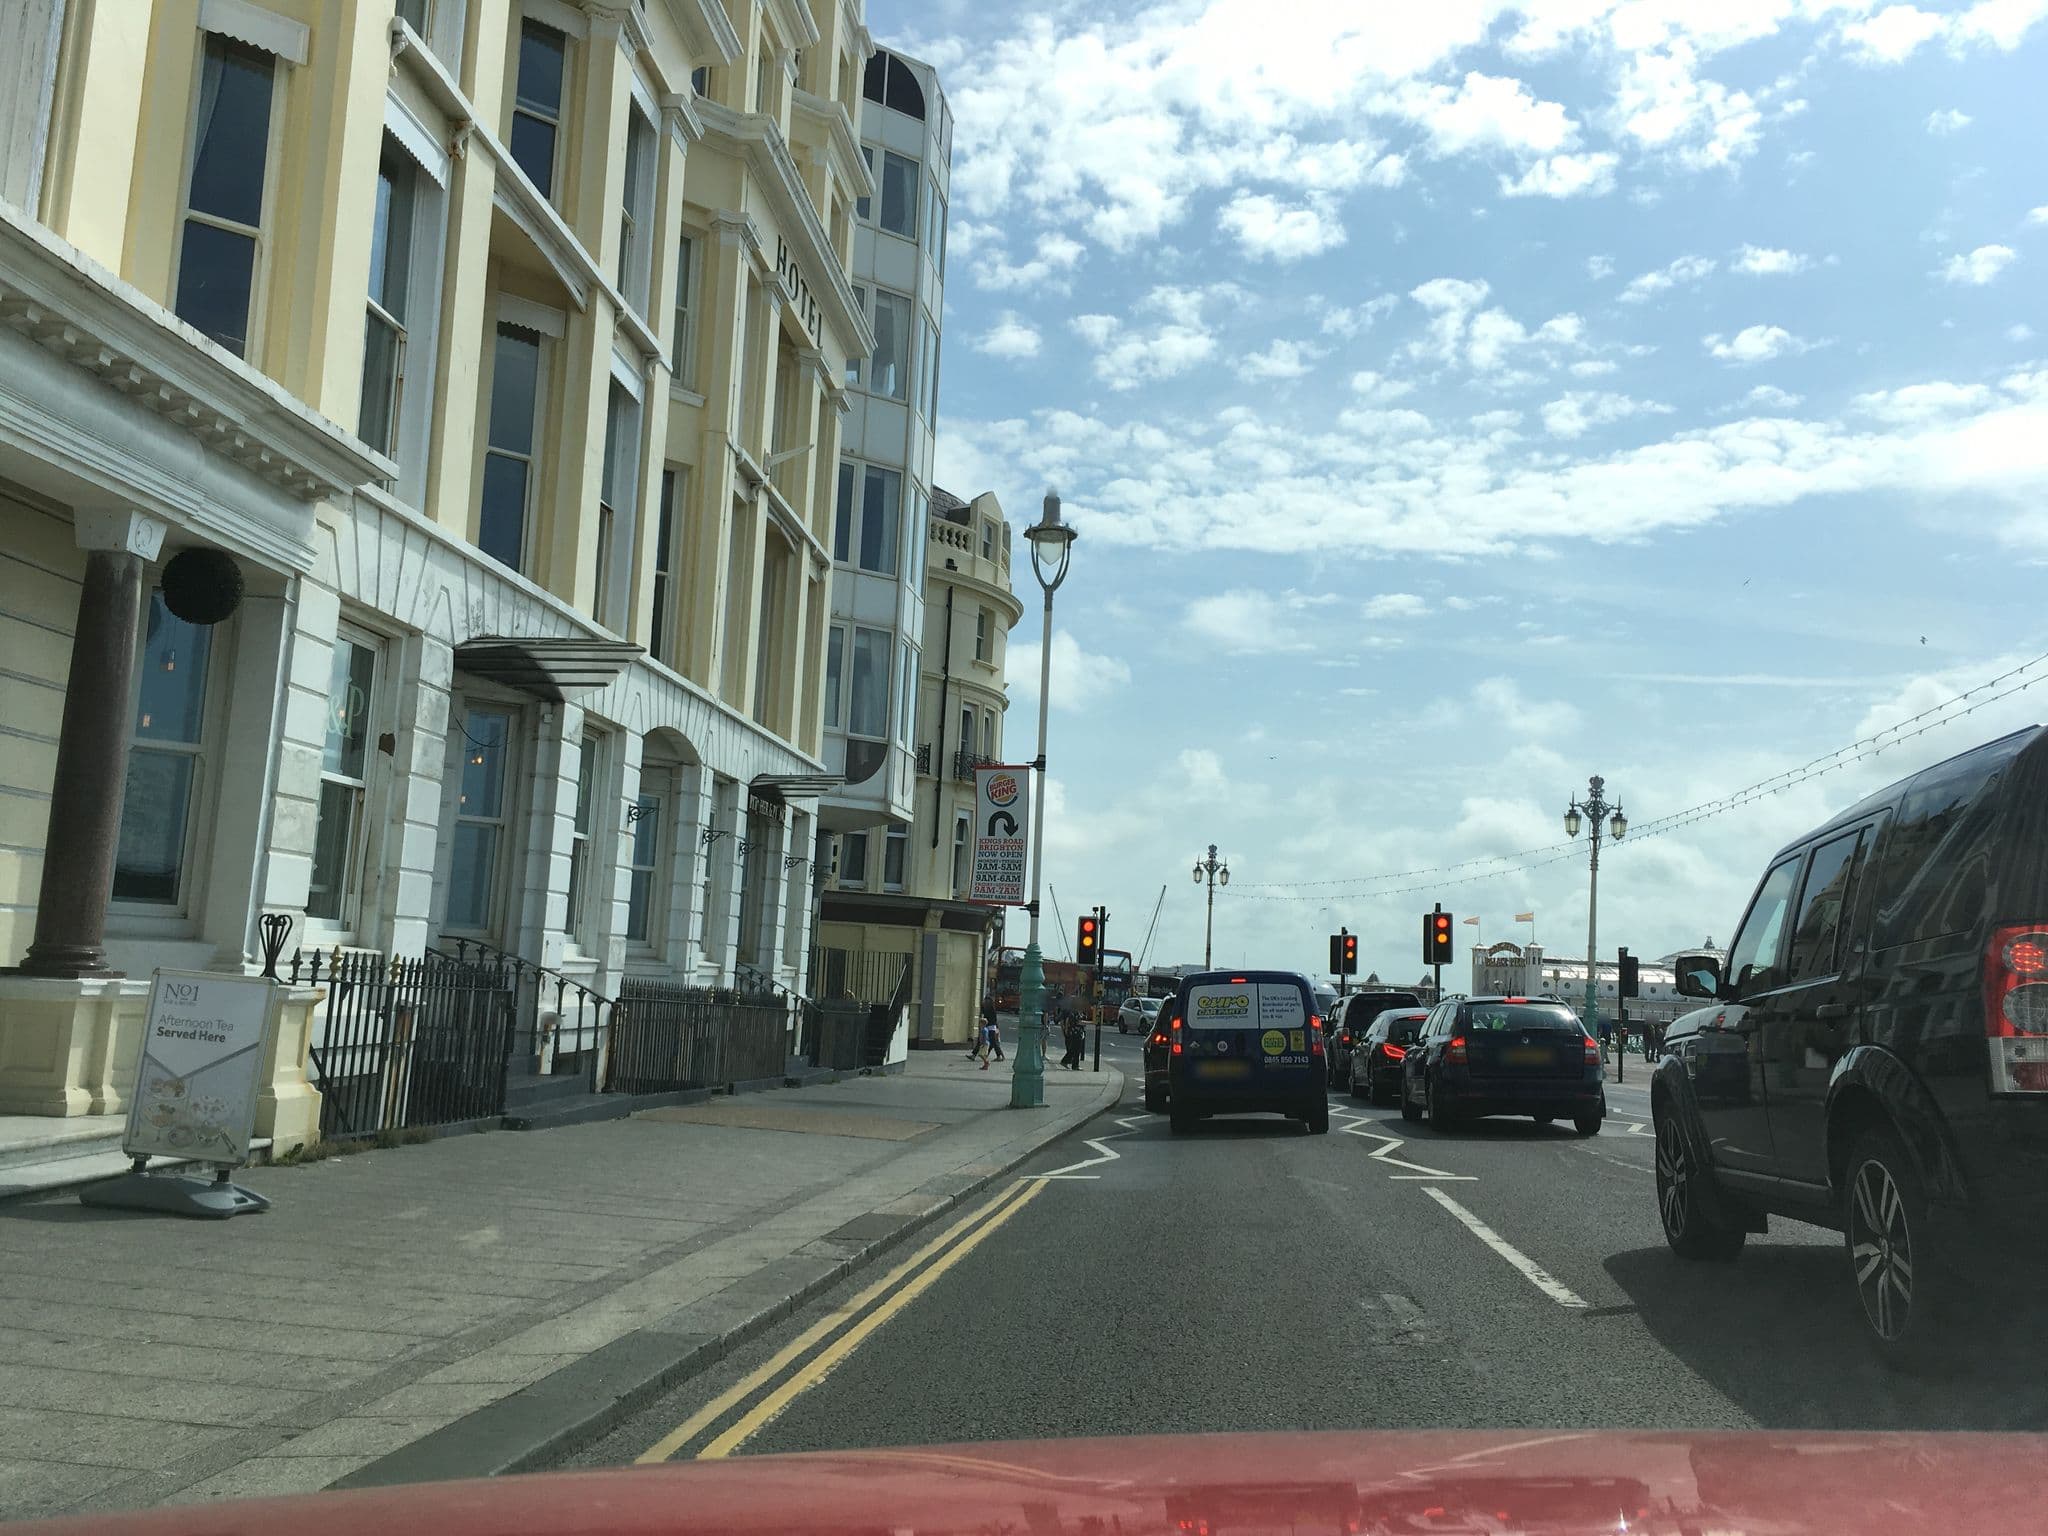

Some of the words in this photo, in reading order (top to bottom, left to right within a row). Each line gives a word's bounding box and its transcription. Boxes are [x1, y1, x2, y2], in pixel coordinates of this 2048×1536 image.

[777, 234, 823, 350] HOTEL
[990, 778, 1016, 790] BURGER
[991, 785, 1017, 800] KING
[977, 863, 1022, 871] 9AM-5AM
[975, 874, 1021, 882] 9AM-6AM
[974, 886, 1020, 895] 9AM-7AM
[1197, 1008, 1217, 1016] CAR
[1218, 1007, 1248, 1015] PARTS
[159, 1014, 213, 1029] Afternoon
[216, 1019, 234, 1031] Tea
[157, 1026, 197, 1040] Served
[198, 1030, 226, 1042] Here
[1294, 1055, 1309, 1063] 7143
